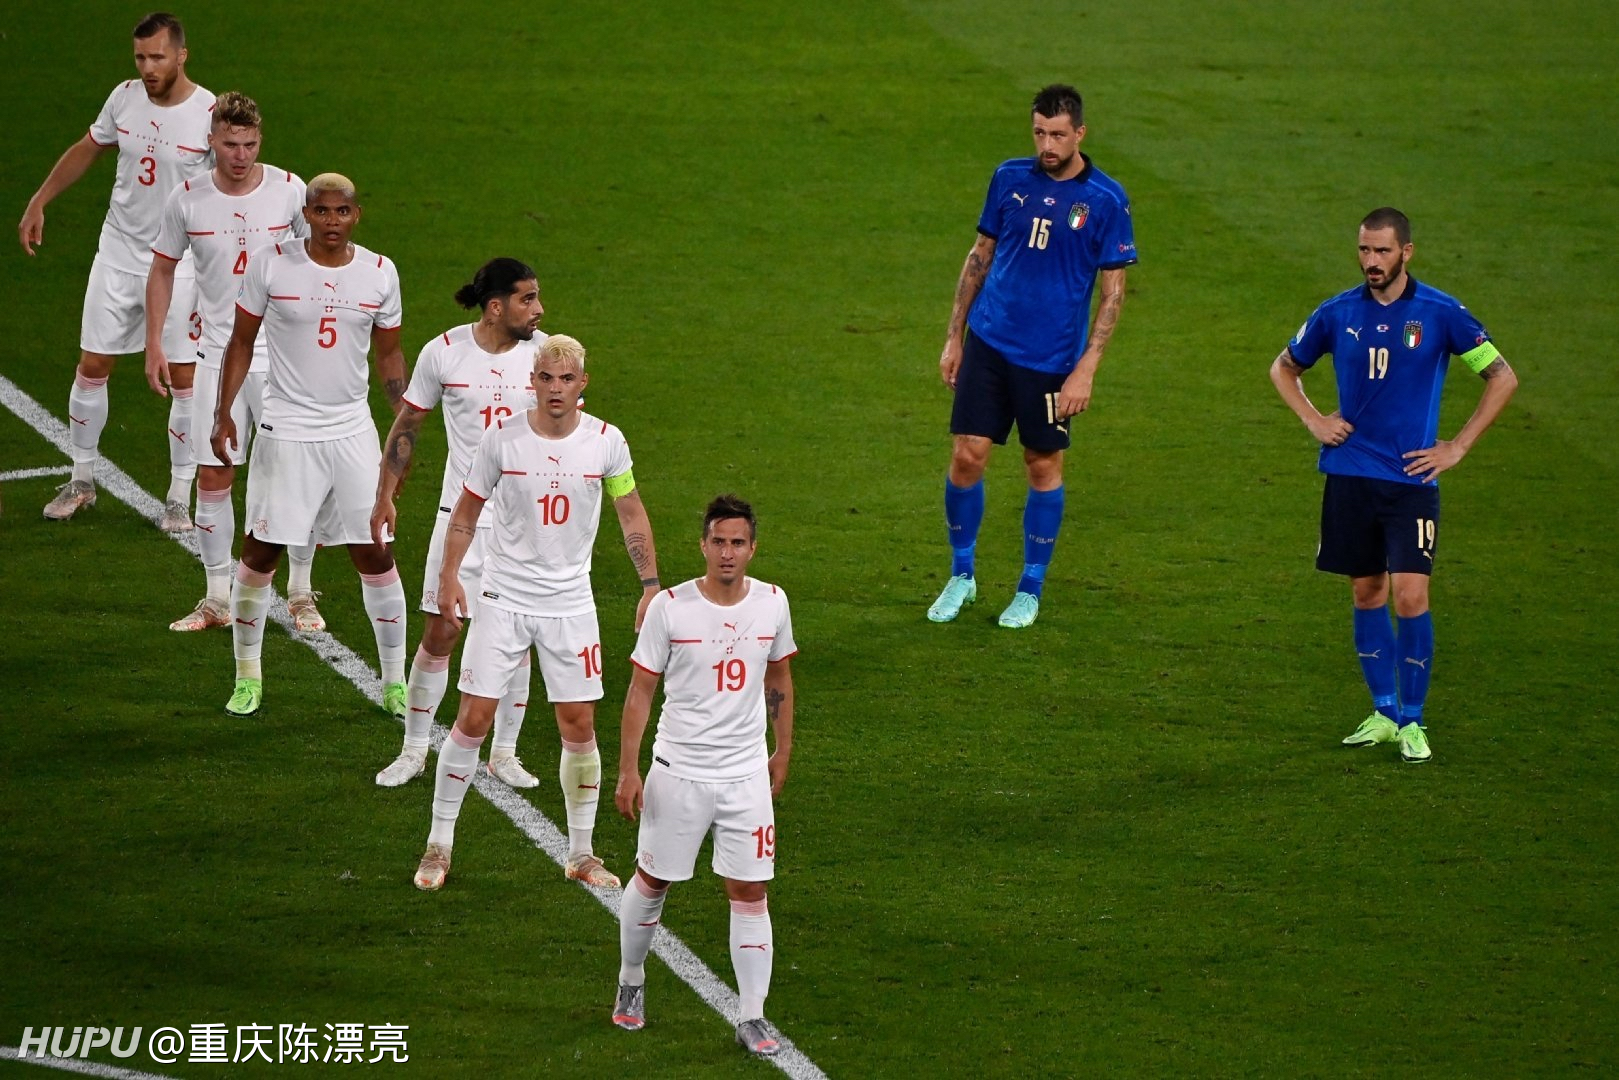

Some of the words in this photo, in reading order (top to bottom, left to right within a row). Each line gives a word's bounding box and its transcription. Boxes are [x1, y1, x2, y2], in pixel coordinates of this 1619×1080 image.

[137, 157, 156, 186] 3
[1028, 217, 1053, 250] 15
[232, 250, 248, 275] 4
[188, 311, 202, 341] 3
[317, 317, 337, 349] 5
[1368, 347, 1389, 379] 19
[537, 493, 570, 526] 10
[1416, 518, 1435, 550] 19
[577, 643, 602, 679] 10
[712, 658, 747, 692] 19
[751, 824, 775, 859] 19
